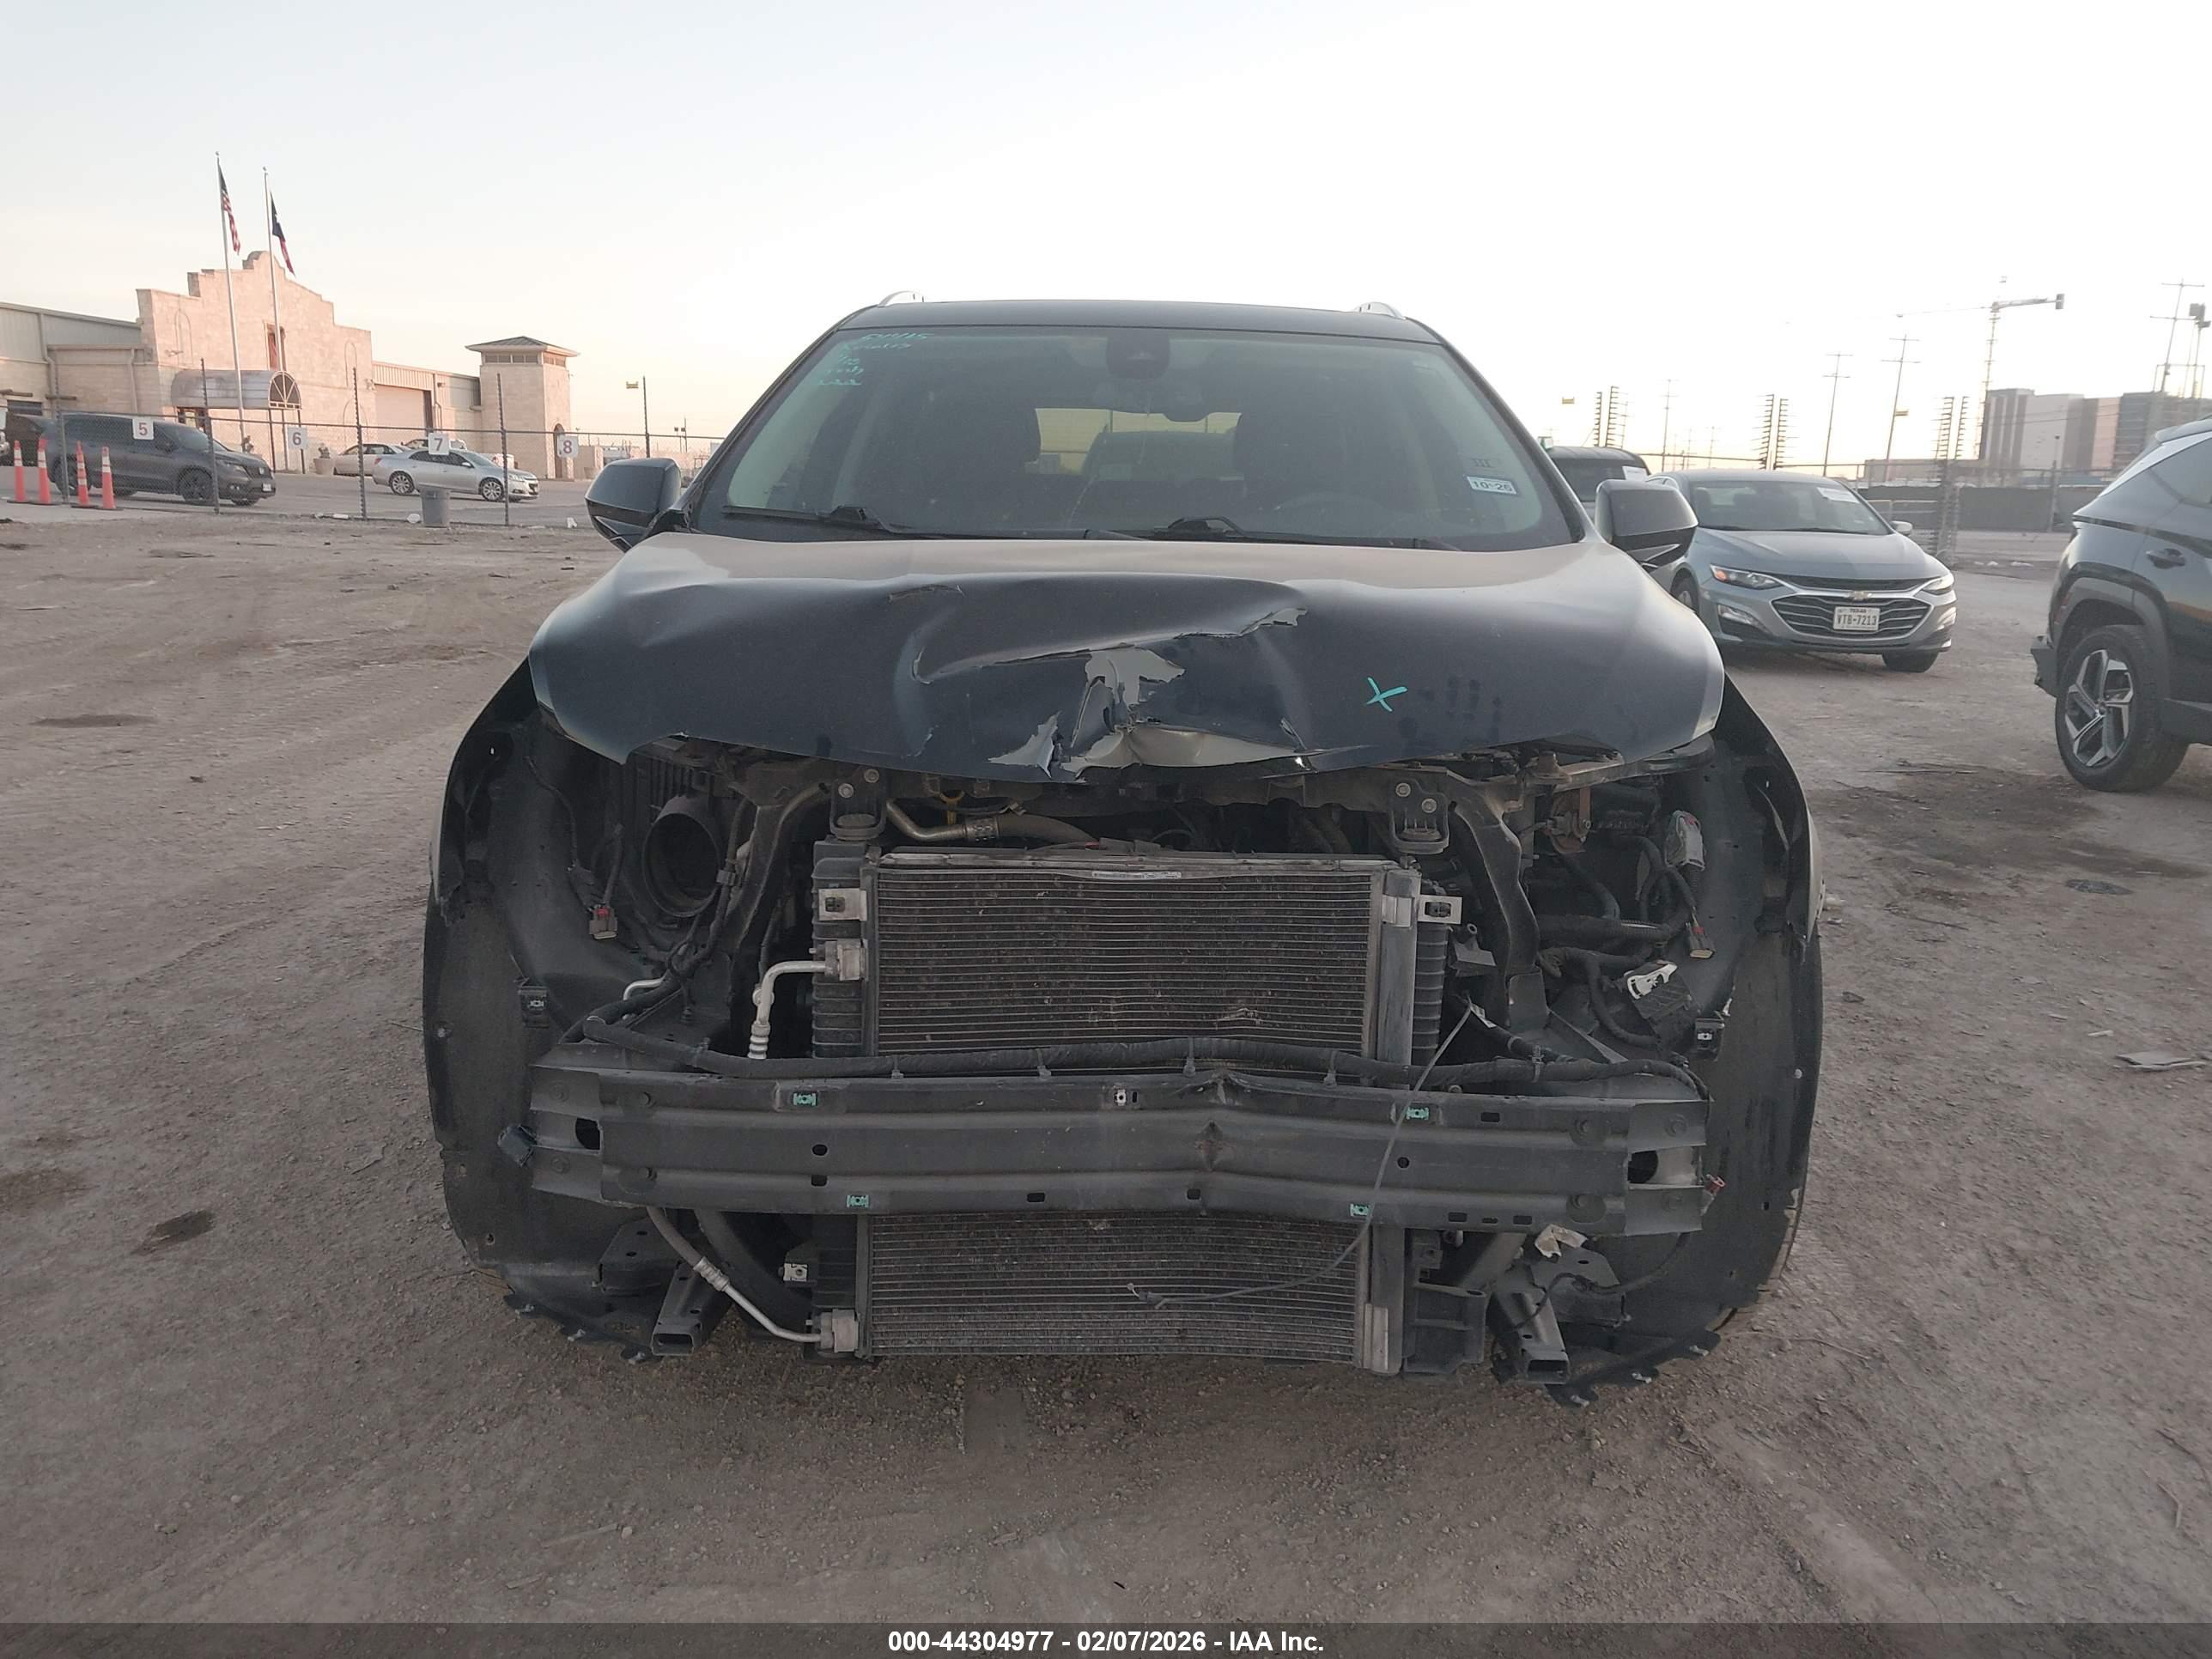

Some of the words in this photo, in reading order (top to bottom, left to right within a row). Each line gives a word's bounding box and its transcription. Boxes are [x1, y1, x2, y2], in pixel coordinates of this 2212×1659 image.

[138, 422, 149, 436] 5
[292, 431, 303, 447] 6
[434, 437, 444, 452] 7
[562, 439, 573, 454] 8
